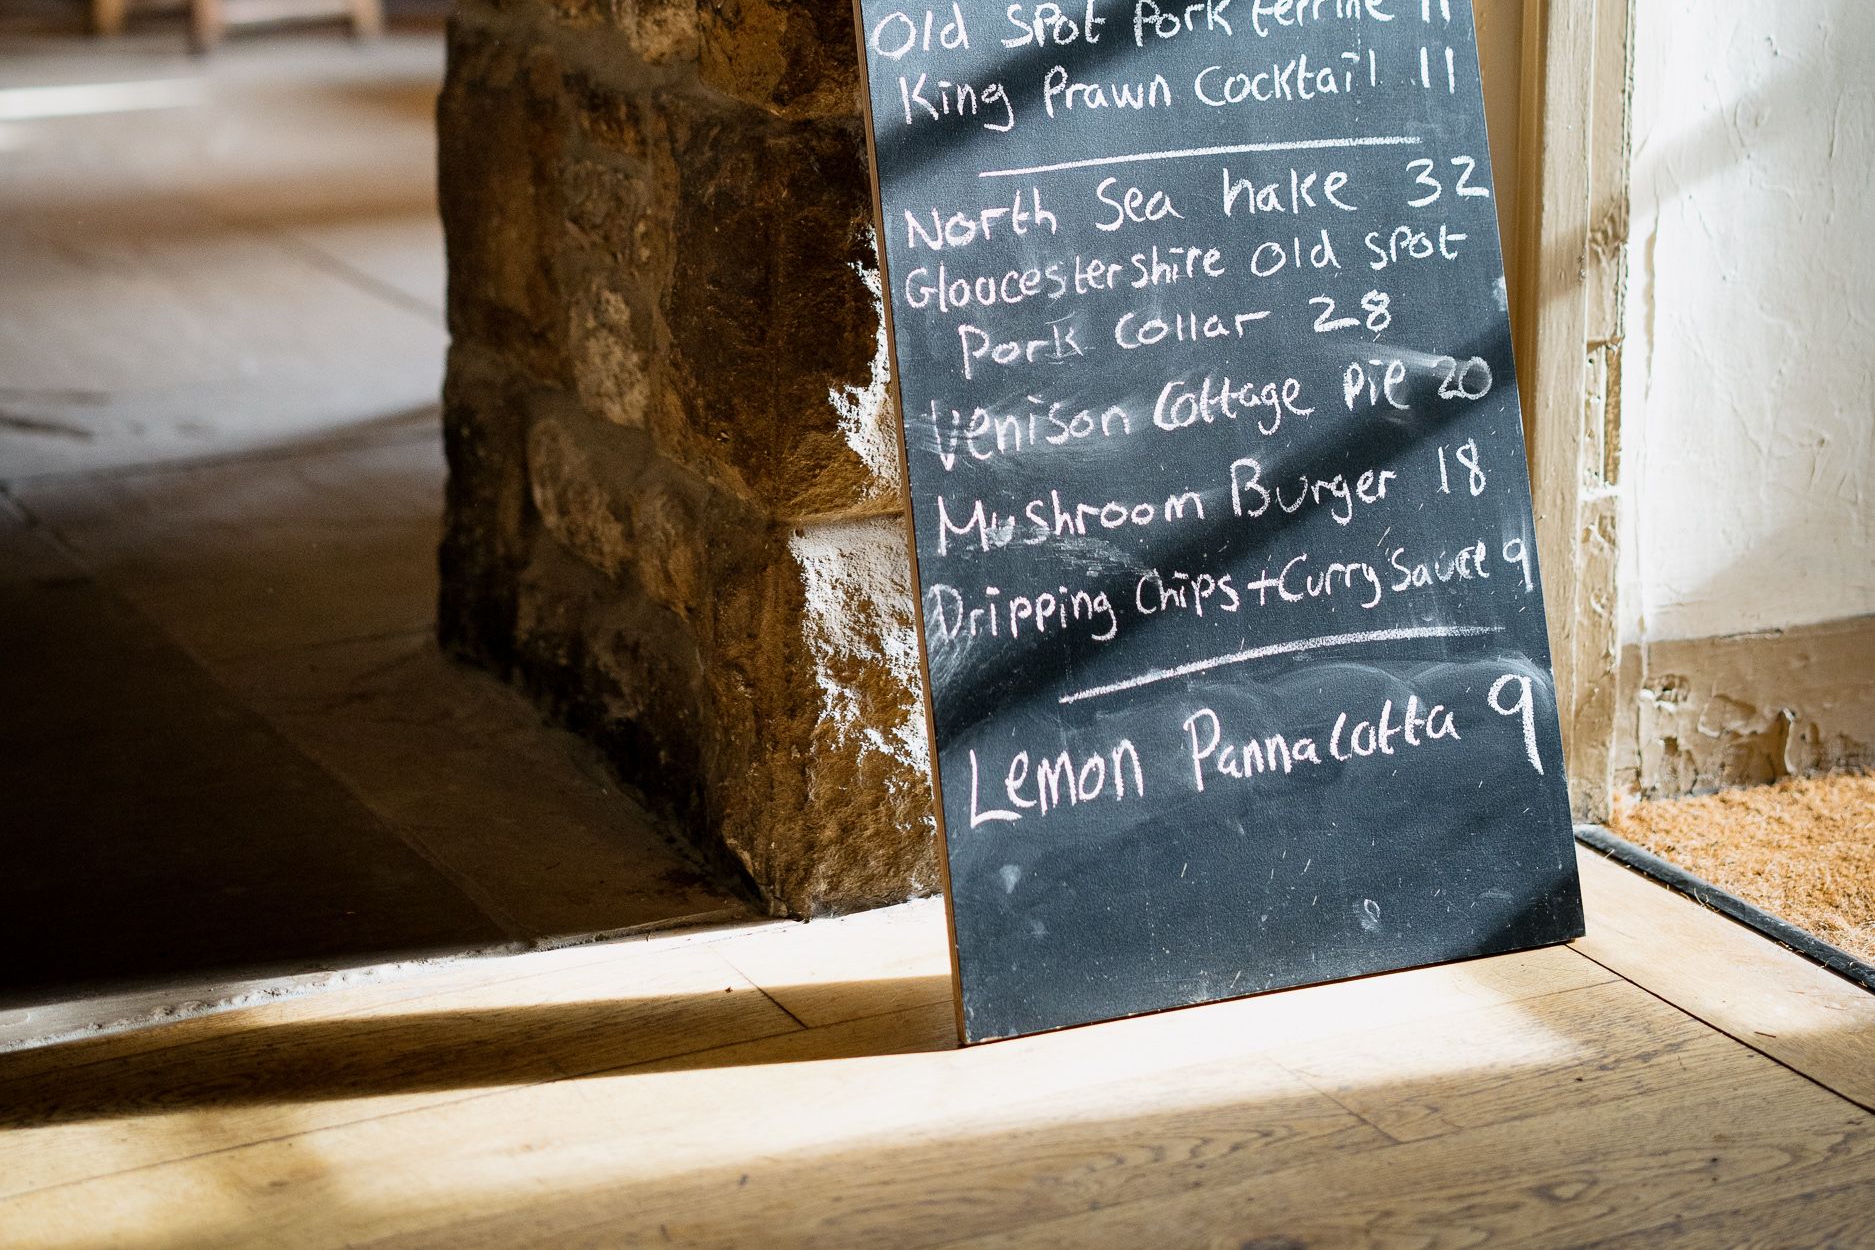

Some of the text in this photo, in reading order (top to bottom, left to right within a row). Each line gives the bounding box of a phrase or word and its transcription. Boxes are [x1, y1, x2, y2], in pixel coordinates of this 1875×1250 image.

[871, 3, 971, 60] Old
[899, 46, 1455, 132] King Prawn Cocktail 11
[905, 186, 1058, 251] North
[1096, 178, 1184, 232] Sea
[1406, 155, 1490, 208] 32
[1251, 229, 1341, 277] Old
[957, 322, 1085, 380] Pork
[1307, 288, 1392, 334] 28
[929, 394, 1131, 472] Venison
[1153, 375, 1315, 436] Cottage
[1435, 355, 1493, 401] 20
[938, 438, 1489, 558] Mushroom Burger 18
[930, 580, 1117, 643] Dripping
[1390, 538, 1492, 593] Sauce
[1501, 536, 1534, 593] 9
[969, 733, 1144, 830] Lemon
[1486, 673, 1545, 776] 9
